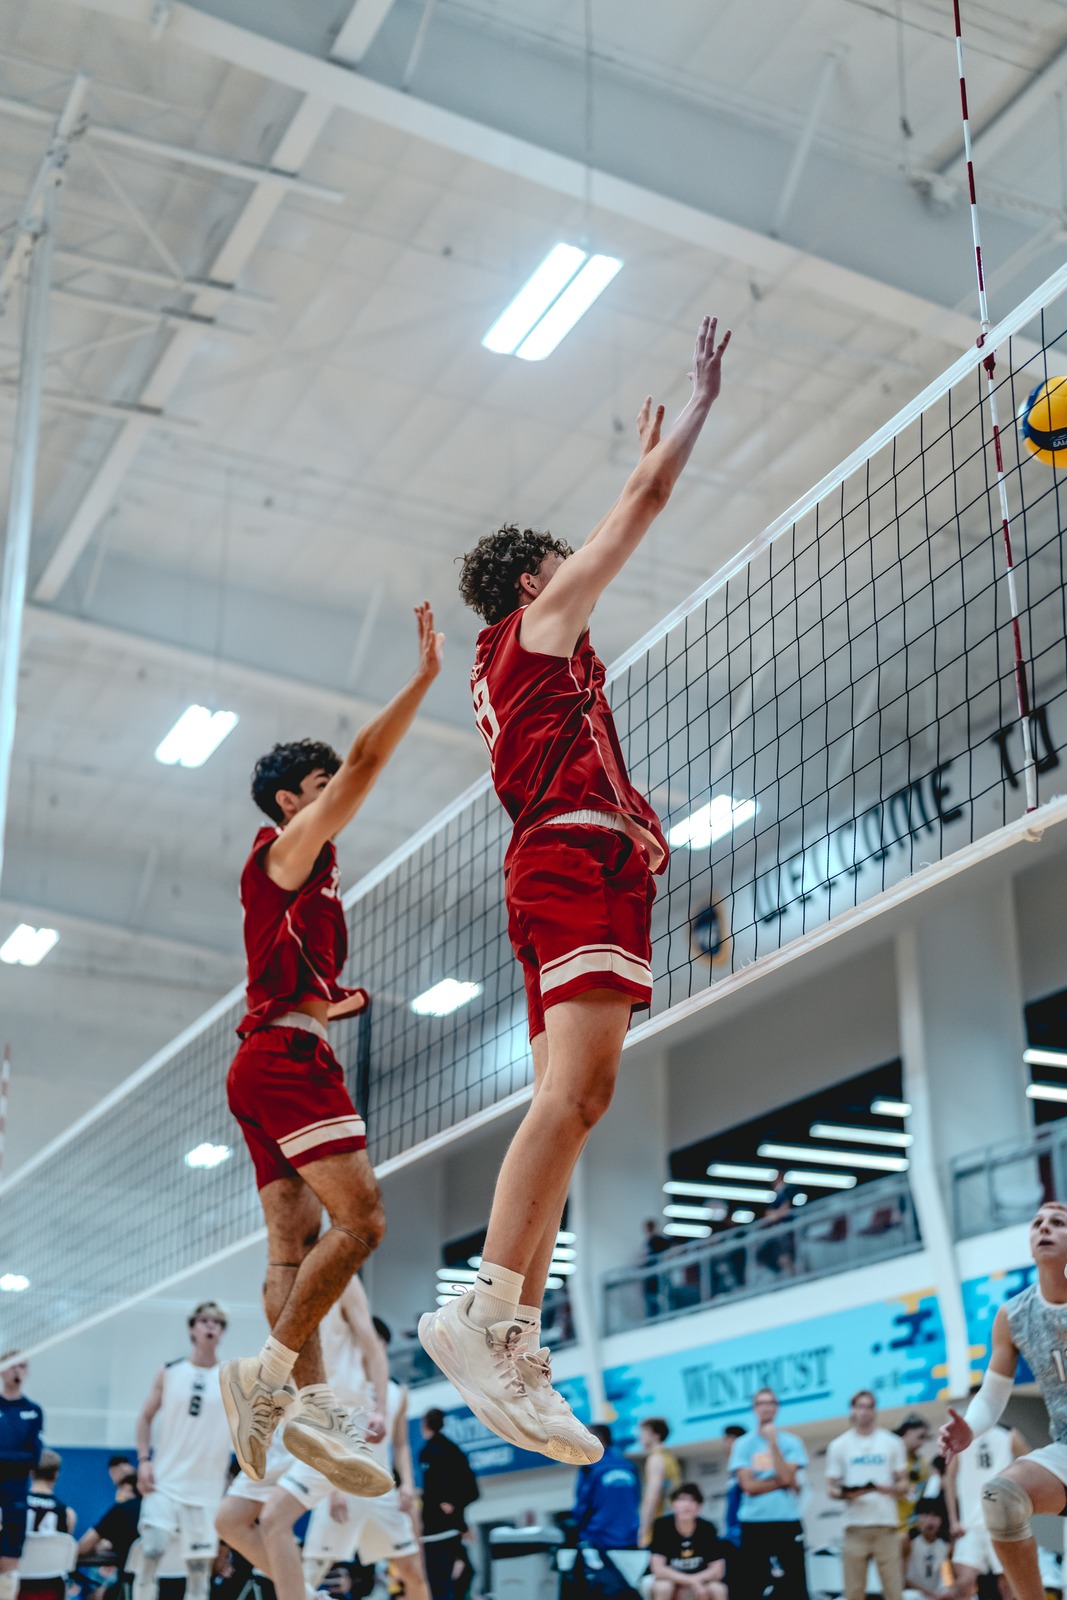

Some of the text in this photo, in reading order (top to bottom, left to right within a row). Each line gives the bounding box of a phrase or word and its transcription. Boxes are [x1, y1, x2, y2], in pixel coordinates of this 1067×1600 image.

[751, 706, 1060, 923] WELCOME TO
[681, 1344, 836, 1411] WINTRUST
